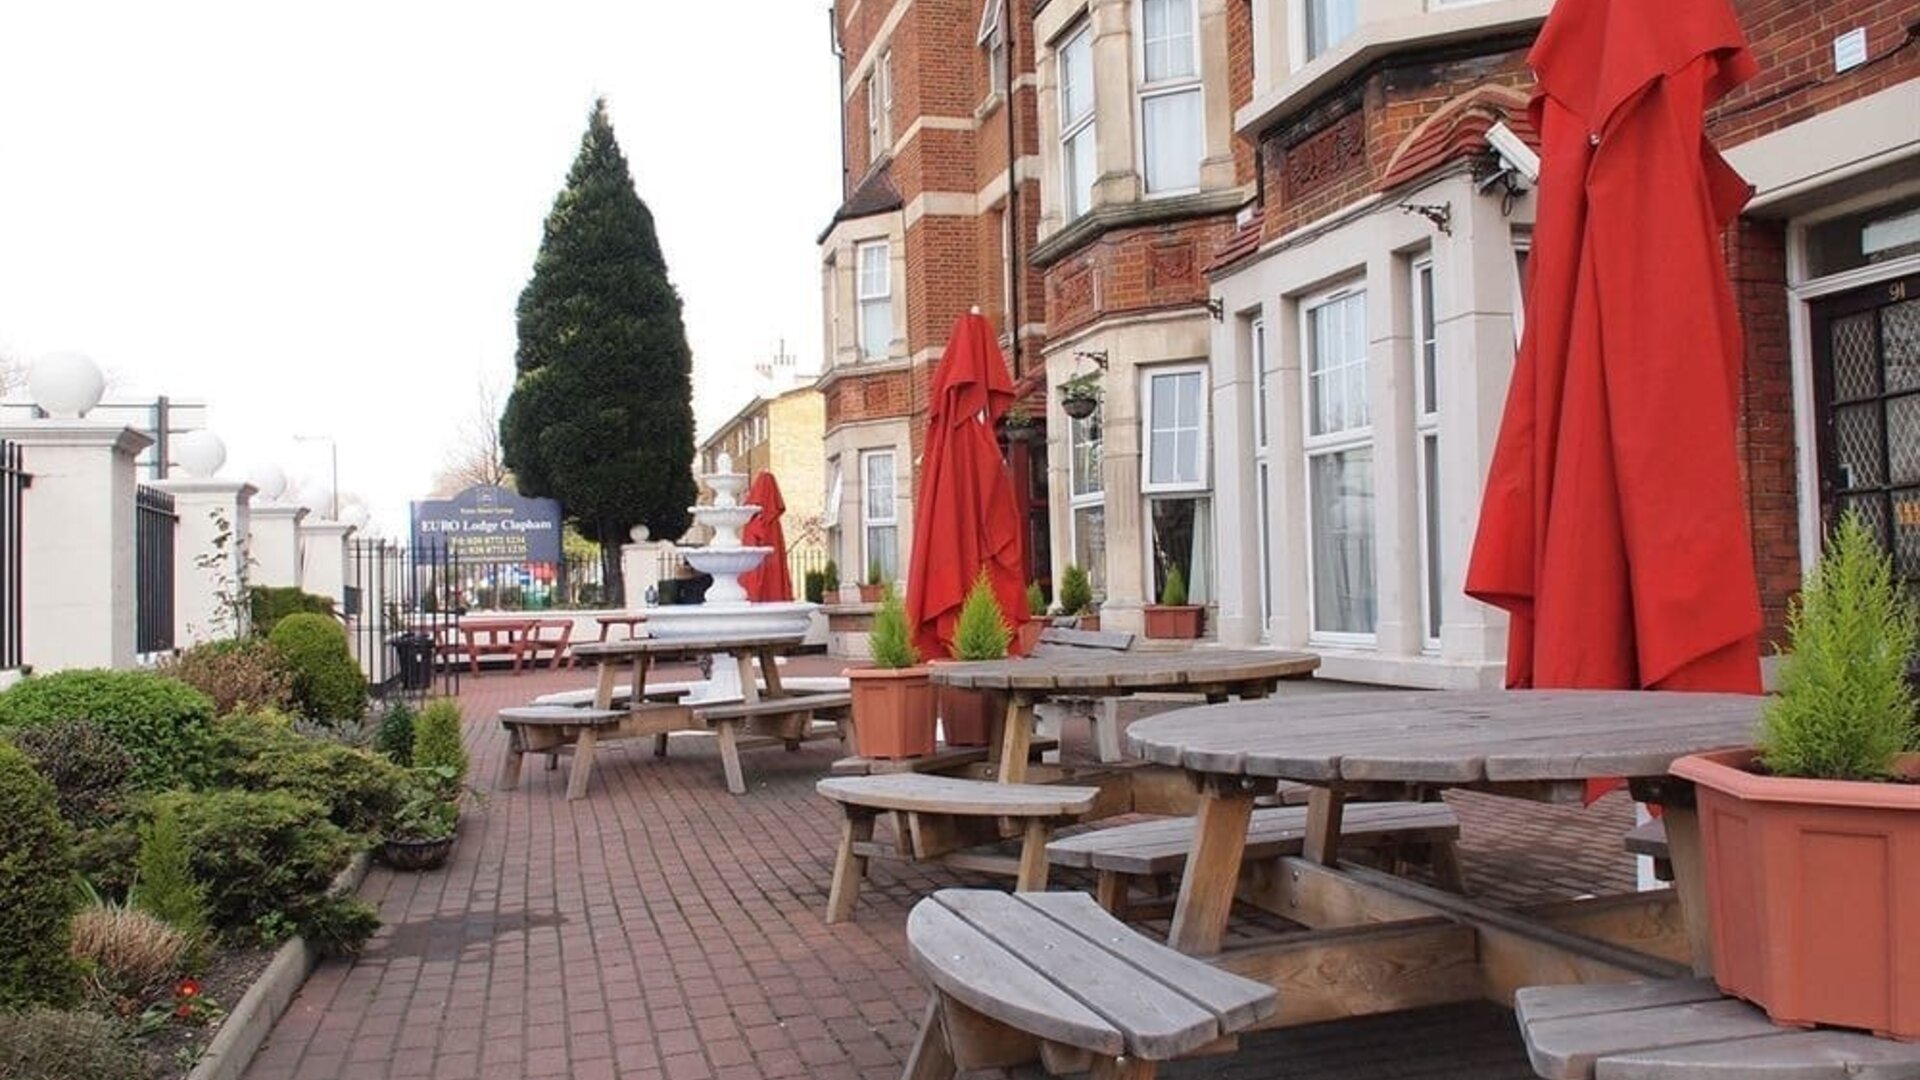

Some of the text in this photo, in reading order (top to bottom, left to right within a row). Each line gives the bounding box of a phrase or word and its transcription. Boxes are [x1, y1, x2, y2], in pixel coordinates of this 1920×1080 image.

[1888, 280, 1906, 302] 91
[421, 519, 552, 533] EURO Lodge Clapham
